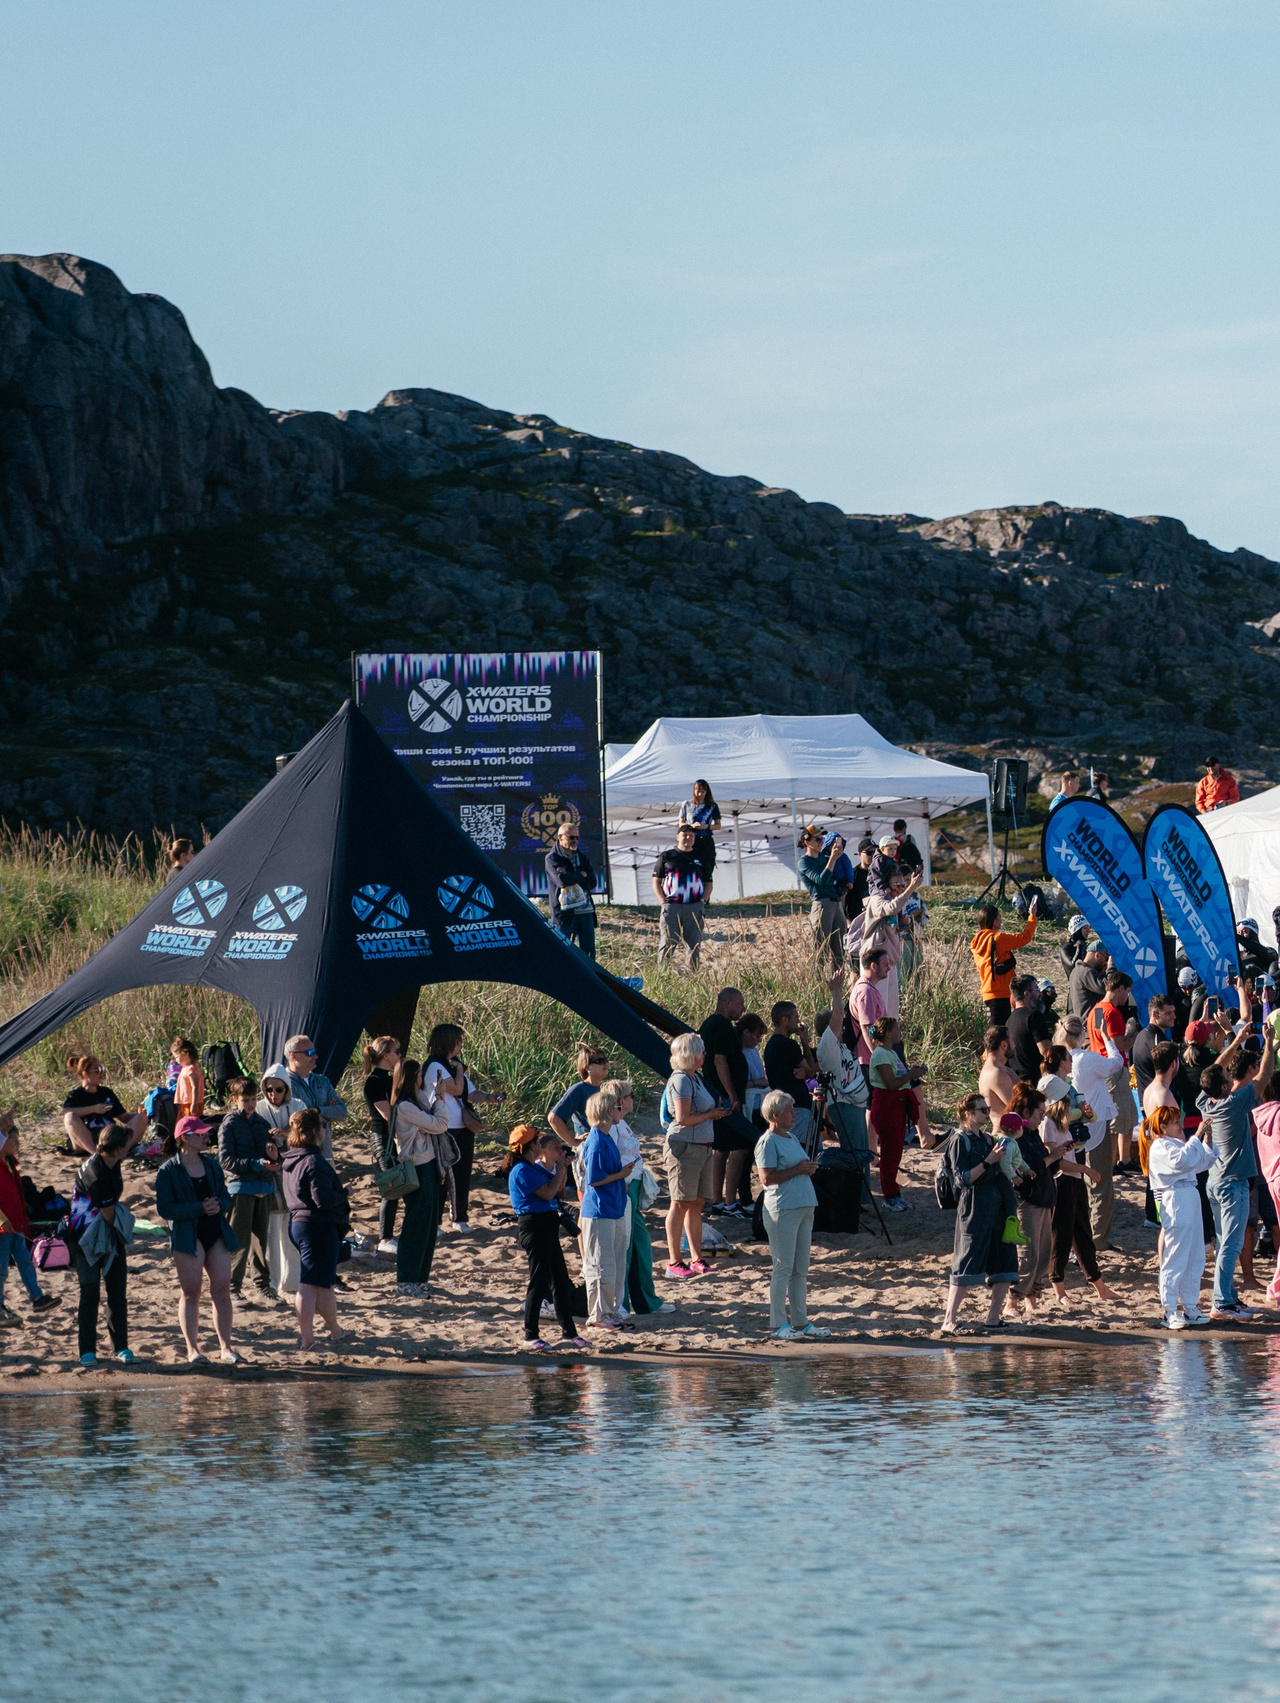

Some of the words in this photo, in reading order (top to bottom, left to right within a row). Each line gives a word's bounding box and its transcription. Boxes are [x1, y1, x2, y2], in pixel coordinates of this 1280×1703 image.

[466, 697, 552, 713] WORLD
[467, 713, 552, 723] CHAMPIONSHIP
[454, 746, 462, 755] 5
[464, 747, 506, 756] лучших
[508, 744, 576, 756] результатов
[432, 758, 471, 767] сезона
[473, 758, 480, 766] в
[482, 756, 533, 766] ТОП-100!
[530, 810, 571, 827] 100
[1075, 817, 1131, 892] WORLD
[1067, 832, 1122, 899] CHAMPIONSHIP
[1167, 825, 1212, 902] WORLD
[1161, 841, 1203, 909] CHAMPIONSHIP
[145, 932, 211, 951] WORLD
[447, 927, 519, 945] WORLD
[140, 944, 205, 957] CHAMPIONSHIP
[228, 939, 293, 954] WORLD
[357, 938, 430, 954] WORLD
[454, 939, 522, 952] CHAMPIONSHIP
[223, 952, 287, 960] CHAMPIONSHIP
